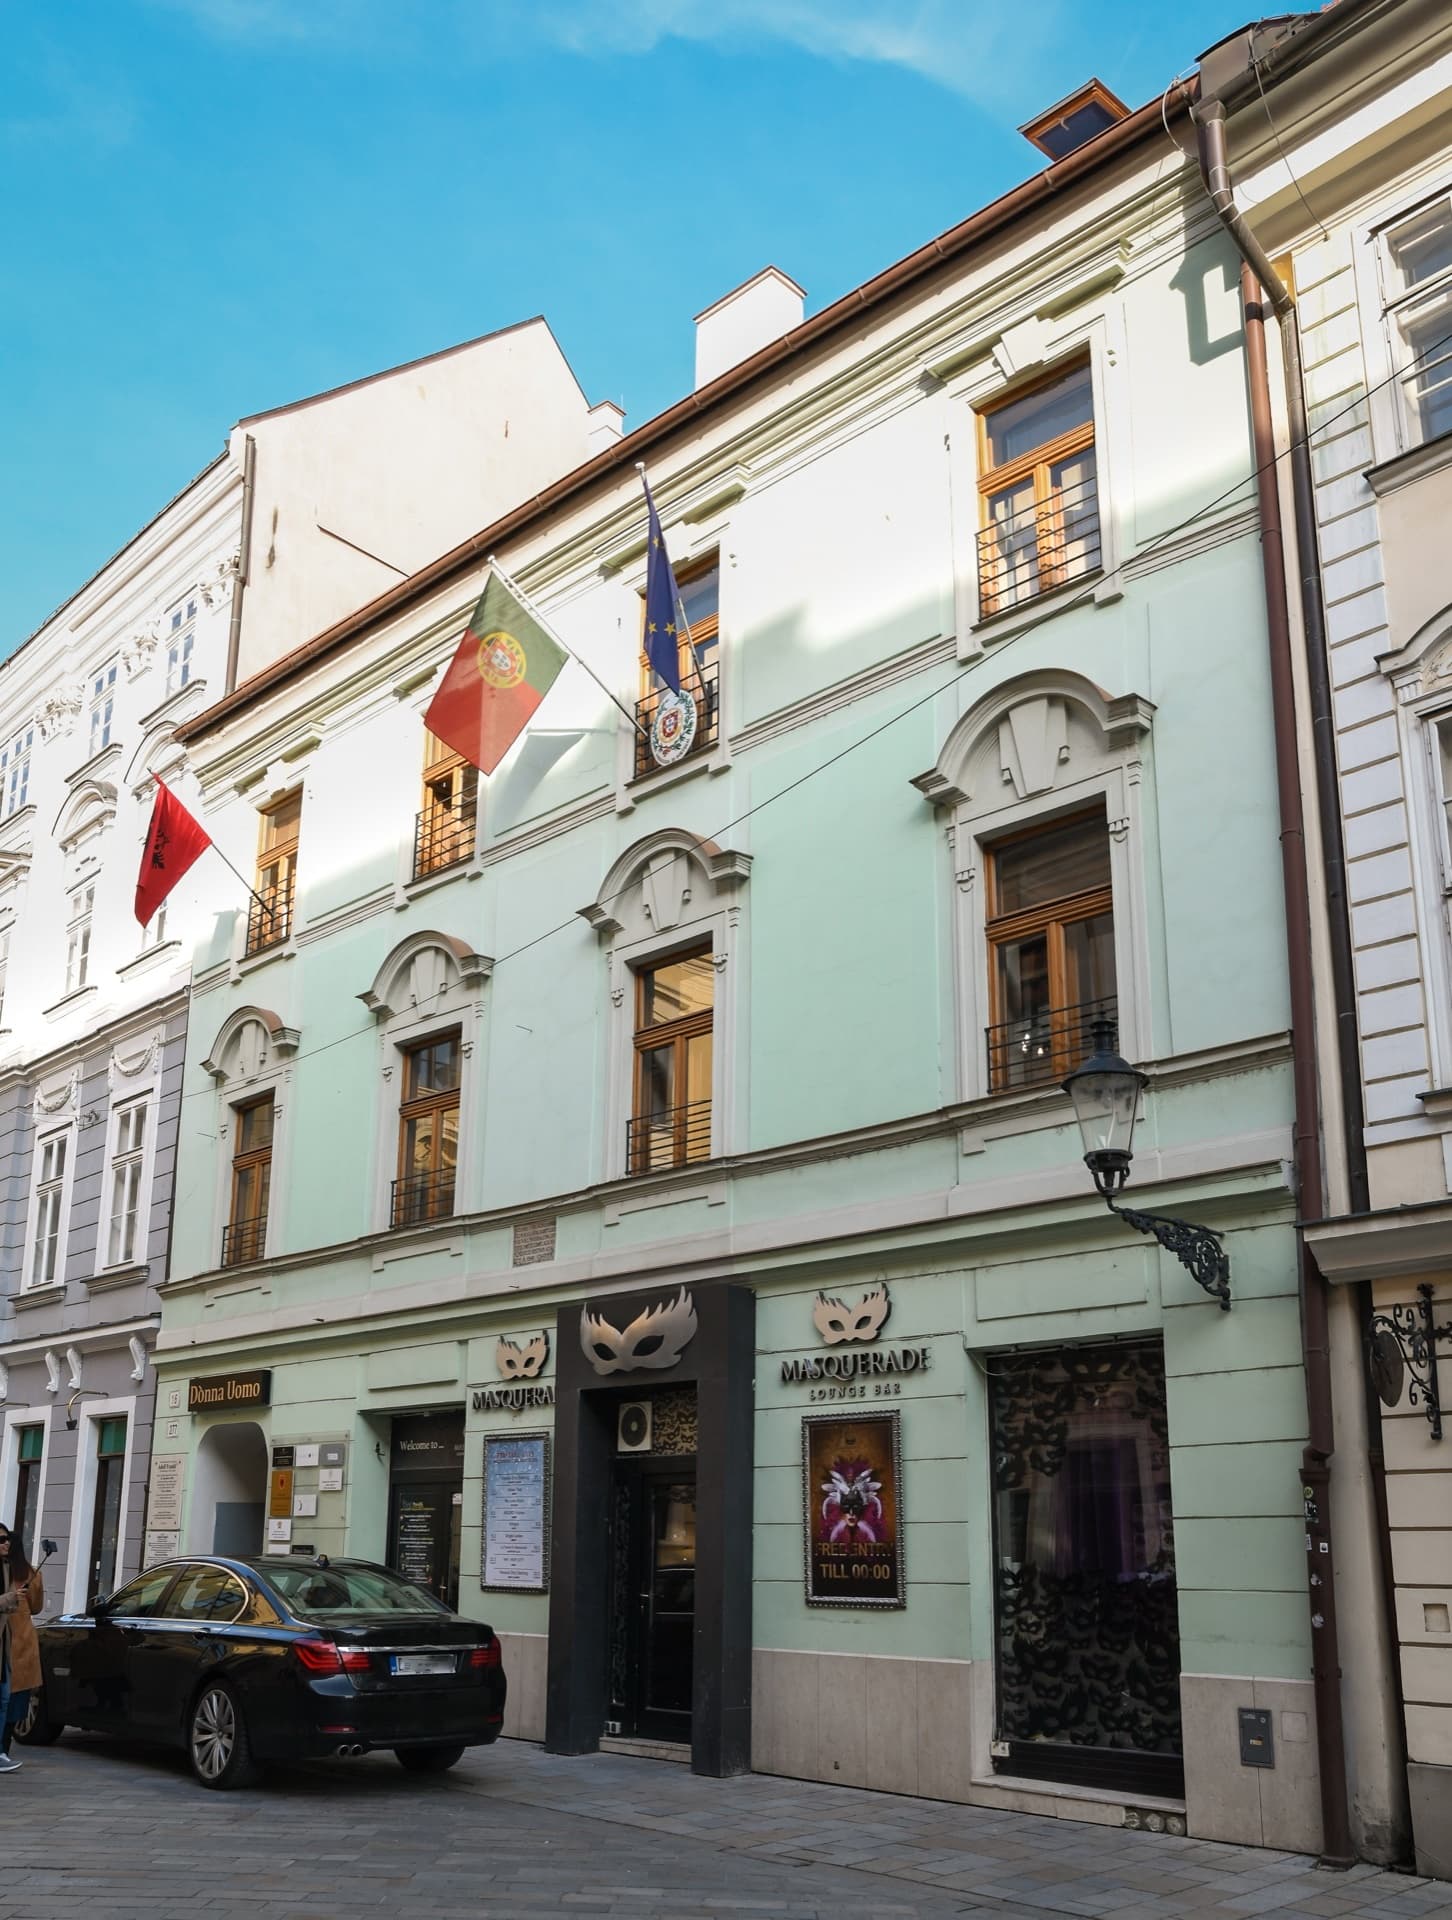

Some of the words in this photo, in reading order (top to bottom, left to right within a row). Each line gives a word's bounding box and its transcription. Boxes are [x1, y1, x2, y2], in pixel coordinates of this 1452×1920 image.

[780, 1347, 933, 1382] MASQUERADE
[227, 1380, 260, 1400] Uomo
[810, 1385, 866, 1401] LOUNGE
[875, 1383, 901, 1396] BAR
[820, 1563, 849, 1579] TILL
[851, 1563, 891, 1580] 00:00
